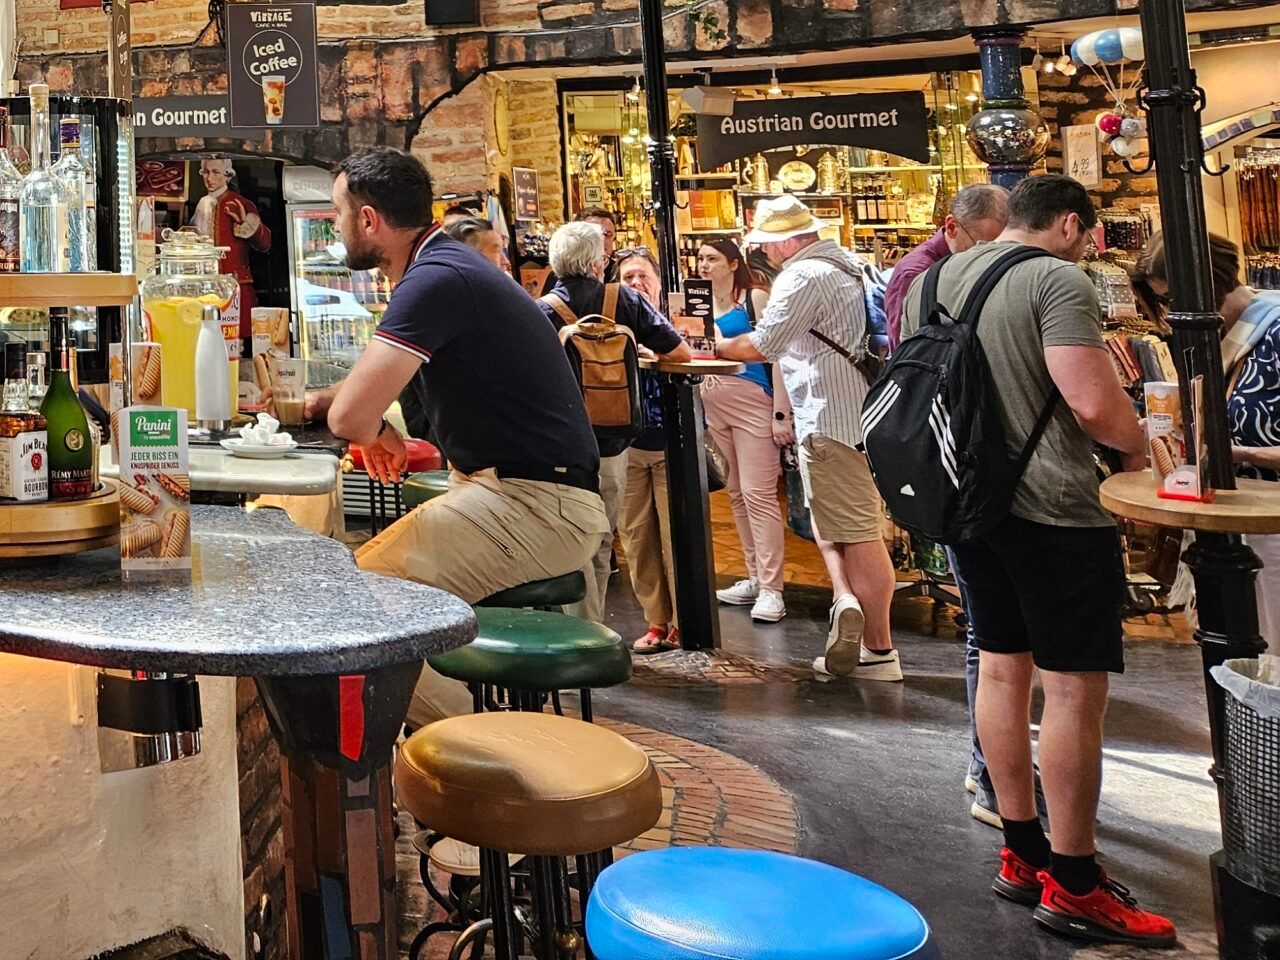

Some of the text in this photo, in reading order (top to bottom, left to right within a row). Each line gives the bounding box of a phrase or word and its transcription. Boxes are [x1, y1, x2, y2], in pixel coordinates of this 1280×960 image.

[253, 38, 285, 58] Iced
[250, 55, 298, 76] Coffee
[151, 107, 227, 126] Gourmet
[721, 108, 898, 135] Austrian Gourmet
[135, 416, 172, 432] Panini
[131, 451, 179, 460] JEDER BISS EIN
